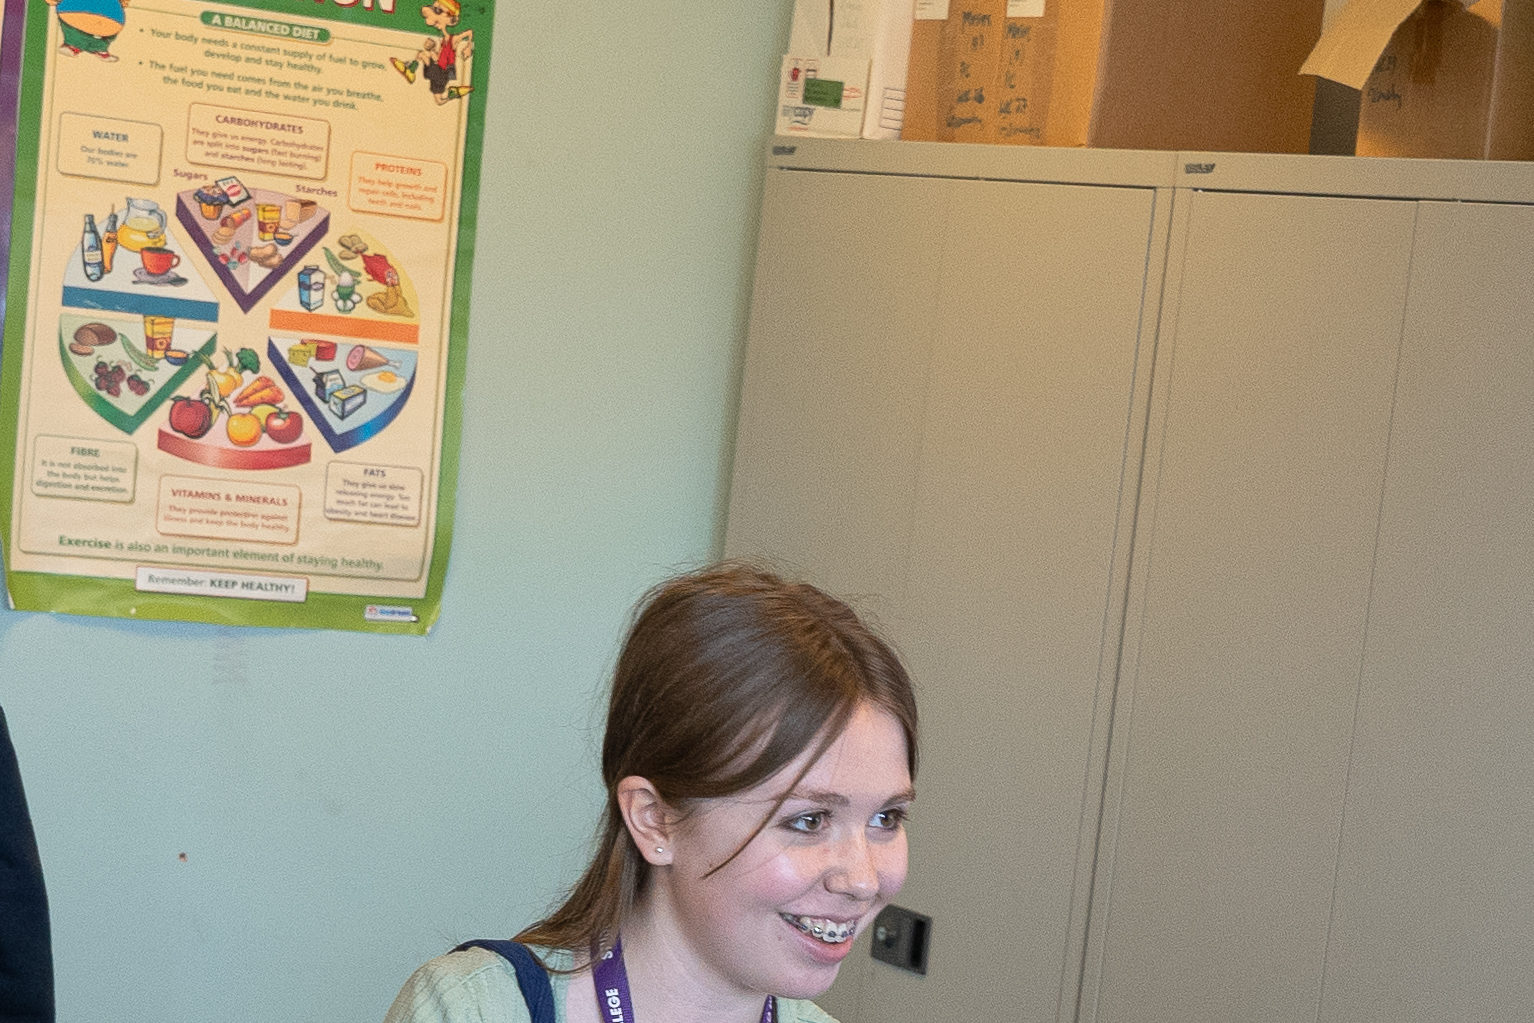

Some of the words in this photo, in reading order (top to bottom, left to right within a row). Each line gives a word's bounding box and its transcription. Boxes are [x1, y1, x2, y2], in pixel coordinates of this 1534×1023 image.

[211, 14, 221, 26] A
[224, 16, 290, 36] BALANCED
[292, 26, 321, 40] DIET
[151, 28, 172, 39] Your
[175, 31, 198, 44] body
[201, 36, 229, 48] needs
[240, 41, 281, 55] constant
[283, 48, 313, 61] supply
[315, 51, 327, 61] of
[328, 53, 347, 64] fuel
[349, 57, 359, 66] to
[204, 49, 242, 63] develop
[244, 54, 262, 65] and
[265, 58, 283, 70] stay
[149, 60, 166, 71] The
[169, 63, 187, 74] fuel
[190, 67, 208, 79] you
[211, 69, 234, 81] need
[237, 73, 266, 85] comes
[269, 76, 292, 88] from
[294, 80, 309, 91] the
[311, 82, 324, 93] air
[326, 86, 344, 97] you
[163, 74, 178, 86] the
[181, 77, 204, 89] food
[206, 80, 224, 93] you
[226, 84, 241, 95] eat
[244, 86, 262, 97] and
[264, 89, 280, 100] the
[283, 92, 310, 104] water
[312, 95, 330, 107] you
[215, 114, 304, 135] CARBOHYDRATES
[92, 130, 129, 142] WATER
[172, 168, 209, 181] Sugars
[295, 184, 338, 197] Starches
[70, 446, 101, 458] FIBRE
[363, 468, 386, 478] FATS
[170, 488, 221, 501] VITAMINS
[224, 493, 232, 503] &
[235, 493, 288, 507] MINERALS
[58, 534, 112, 549] Exercise
[114, 539, 124, 550] is
[126, 540, 151, 552] also
[153, 543, 169, 553] an
[172, 543, 230, 561] important
[232, 548, 280, 562] element
[282, 551, 295, 563] of
[296, 553, 337, 570] staying
[209, 578, 238, 590] KEEP
[240, 580, 296, 594] HEALTHY!
